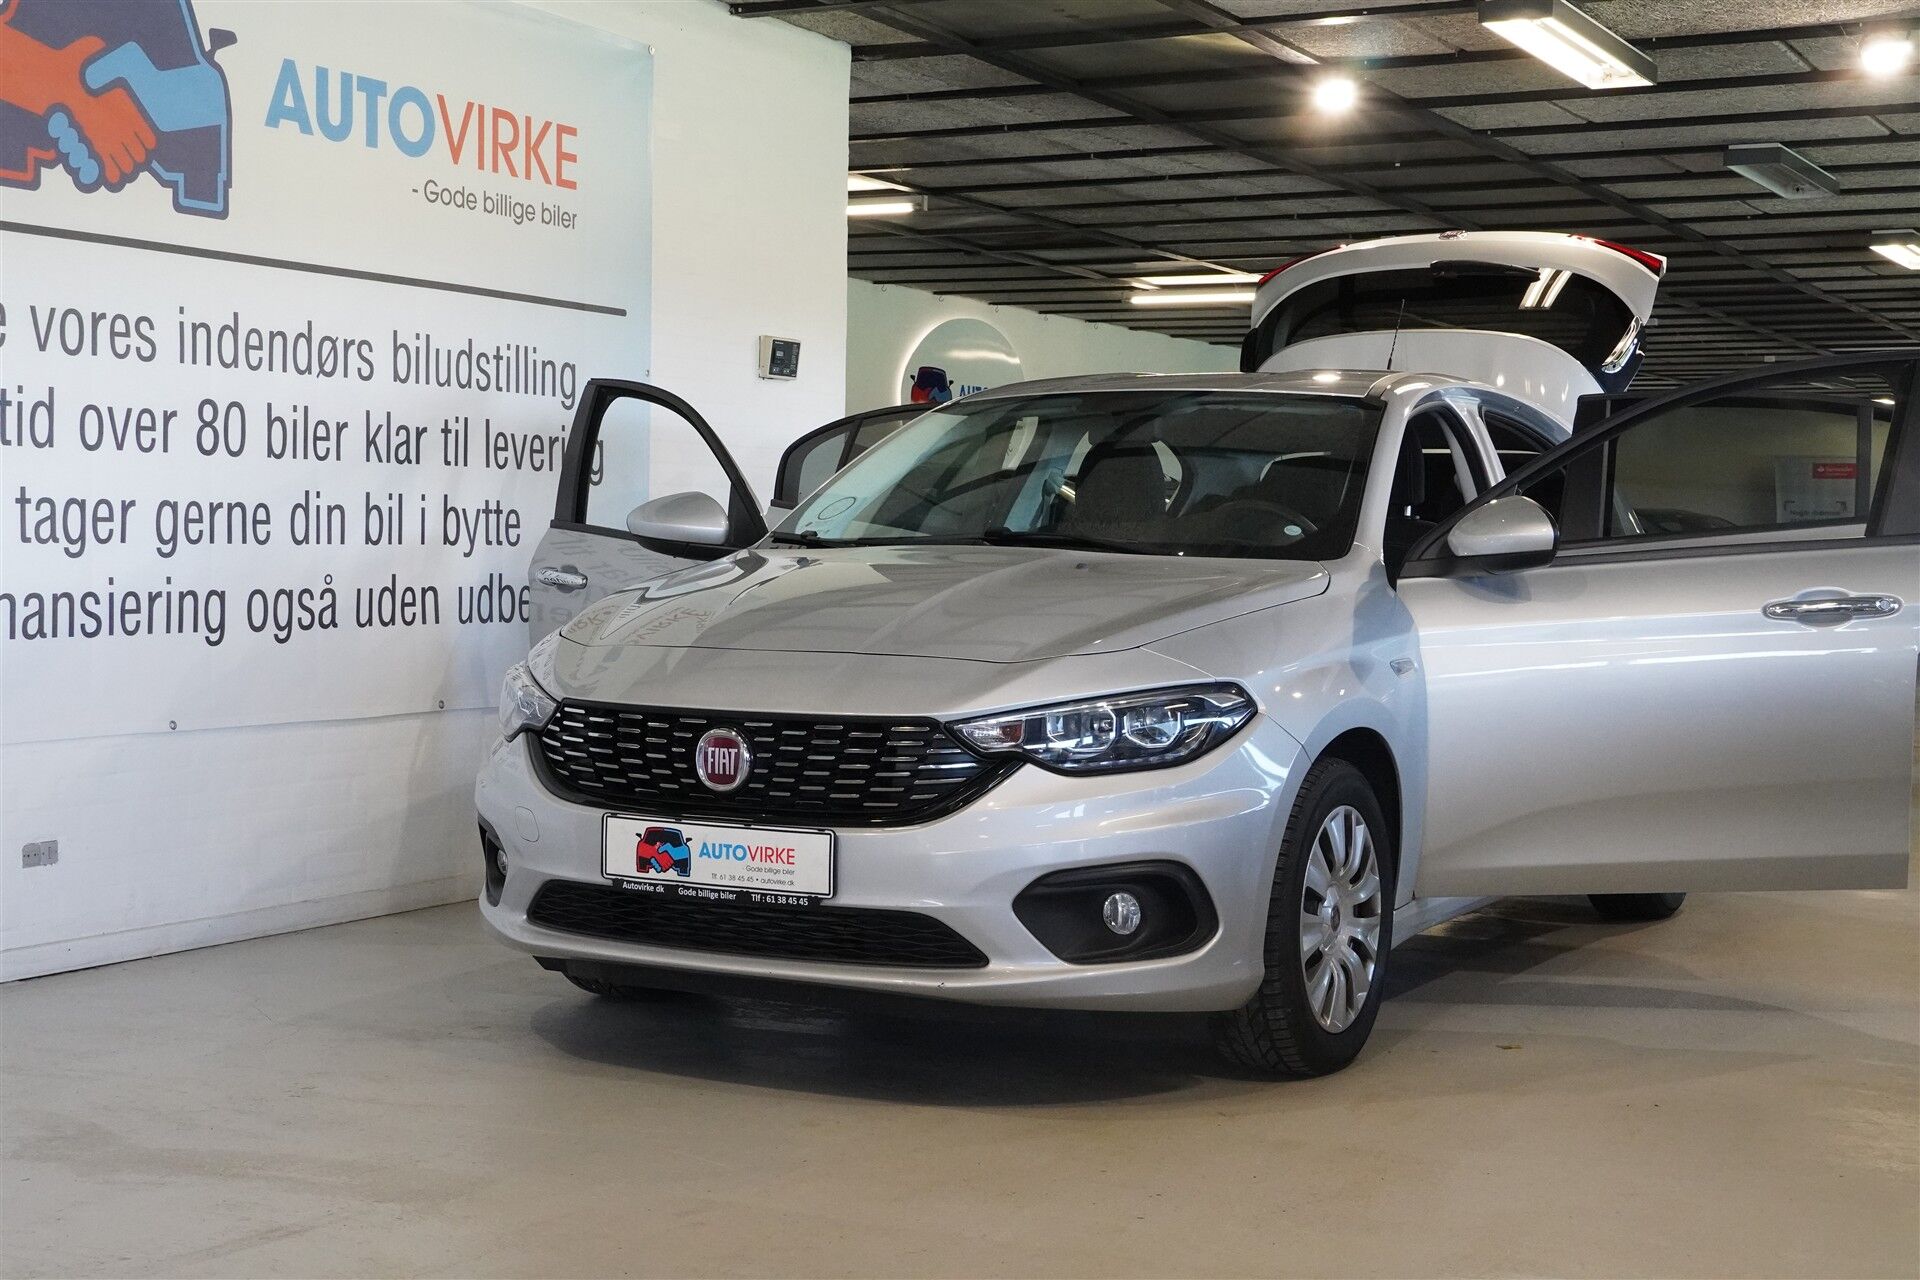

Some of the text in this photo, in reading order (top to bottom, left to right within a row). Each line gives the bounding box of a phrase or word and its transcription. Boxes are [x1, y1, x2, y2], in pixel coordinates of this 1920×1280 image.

[264, 57, 578, 190] AUTOVIRKE
[423, 179, 478, 211] Gode
[483, 190, 536, 225] billige
[541, 202, 577, 230] biler
[29, 305, 157, 362] vores
[178, 306, 375, 385] indendørs
[393, 329, 576, 410] biludstilling
[79, 404, 178, 453] over
[196, 398, 246, 458] 80
[266, 402, 349, 463] biler
[365, 410, 427, 465] klar
[440, 416, 469, 467] til
[485, 418, 604, 486] leverig
[15, 486, 521, 559] tager gerne din bil i bytte
[246, 574, 338, 645] også
[355, 573, 440, 628] uden
[707, 747, 737, 775] FIAT
[698, 841, 795, 865] AUTOVIRKE
[745, 865, 795, 876] Gode billige biler
[622, 881, 654, 892] Autovirke
[678, 887, 697, 897] Gode
[698, 889, 719, 900] billige
[720, 892, 737, 900] biler
[766, 894, 776, 904] 61
[777, 896, 787, 905] 38
[788, 897, 798, 905] 45
[798, 898, 809, 906] 45
